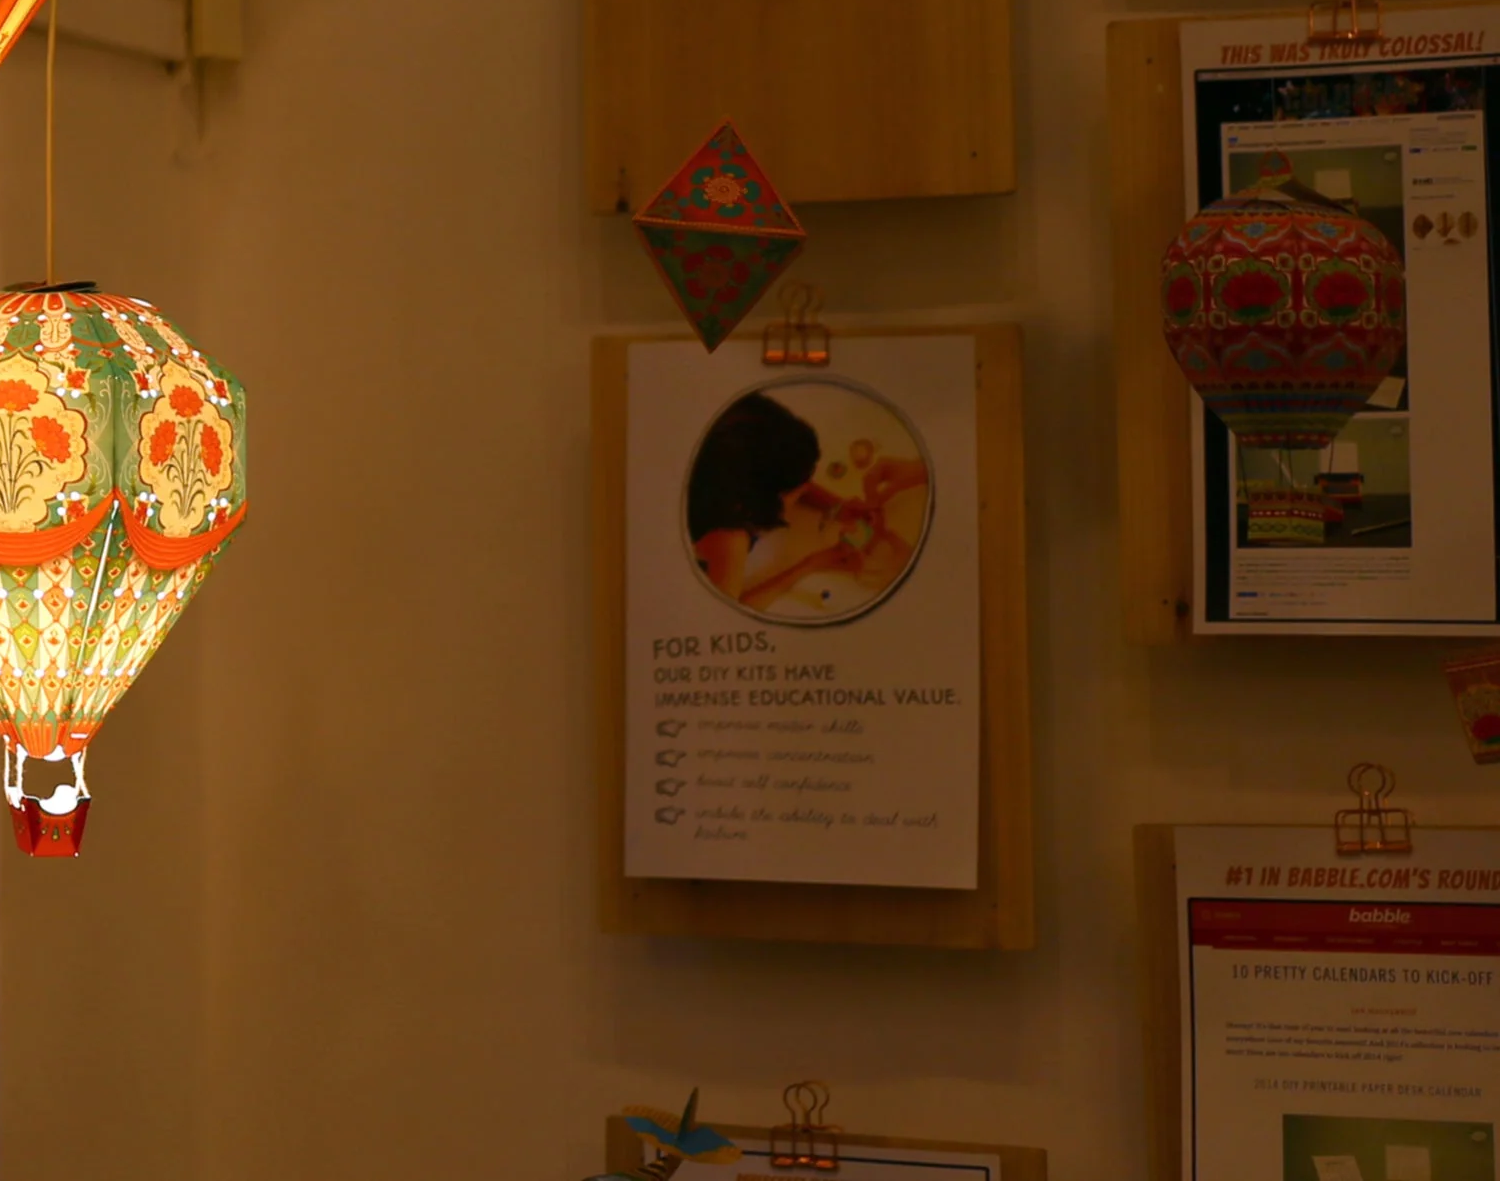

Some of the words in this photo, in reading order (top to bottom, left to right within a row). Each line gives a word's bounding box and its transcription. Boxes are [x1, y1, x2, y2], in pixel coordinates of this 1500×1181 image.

[1220, 44, 1264, 66] THIS
[1269, 41, 1311, 64] WAS
[1318, 39, 1373, 61] TRULY
[1377, 30, 1487, 59] COLOSSAL!
[652, 635, 701, 660] FOR
[709, 630, 777, 656] KIDS,
[653, 666, 693, 684] OUR
[698, 666, 730, 683] DIY
[735, 664, 778, 682] KITS
[784, 663, 837, 682] HAVE
[654, 688, 742, 708] IMMENSE
[749, 687, 886, 708] EDUCATIONAL
[892, 686, 963, 707] VALUE.
[1225, 865, 1254, 886] #1
[1259, 866, 1282, 887] IN
[1286, 865, 1431, 890] BABBLE.COM'S
[1348, 908, 1412, 924] babble
[1231, 964, 1249, 980] 10
[1254, 964, 1307, 983] PRETTY
[1312, 966, 1397, 984] CALENDARS
[1402, 968, 1421, 984] TO
[1425, 968, 1494, 987] KICK-OFF
[1361, 1081, 1396, 1096] PAPER
